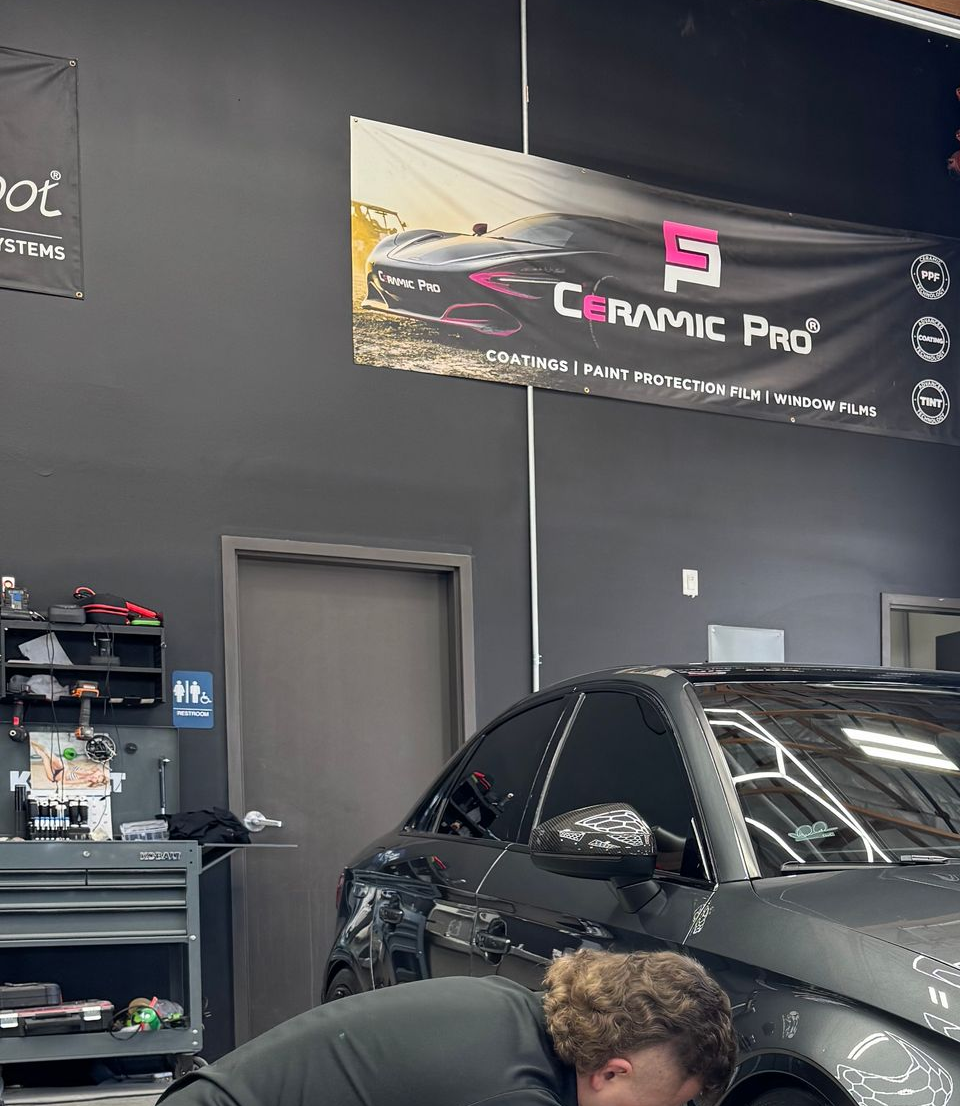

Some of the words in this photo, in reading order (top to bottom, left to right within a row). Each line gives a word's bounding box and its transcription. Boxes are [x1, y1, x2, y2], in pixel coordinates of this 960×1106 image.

[377, 270, 415, 290] CERAMIC
[418, 279, 441, 293] PRO
[921, 270, 940, 282] PPF
[554, 281, 726, 343] CERAMIC
[918, 334, 944, 345] COATING
[486, 349, 568, 374] COATINGS
[584, 363, 628, 381] PAINT
[634, 368, 726, 396] PROTECTION
[730, 385, 761, 402] FILM
[774, 393, 835, 412] WINDOW
[839, 402, 877, 418] FILMS
[919, 396, 942, 408] TINT
[176, 710, 210, 718] RESTROOM
